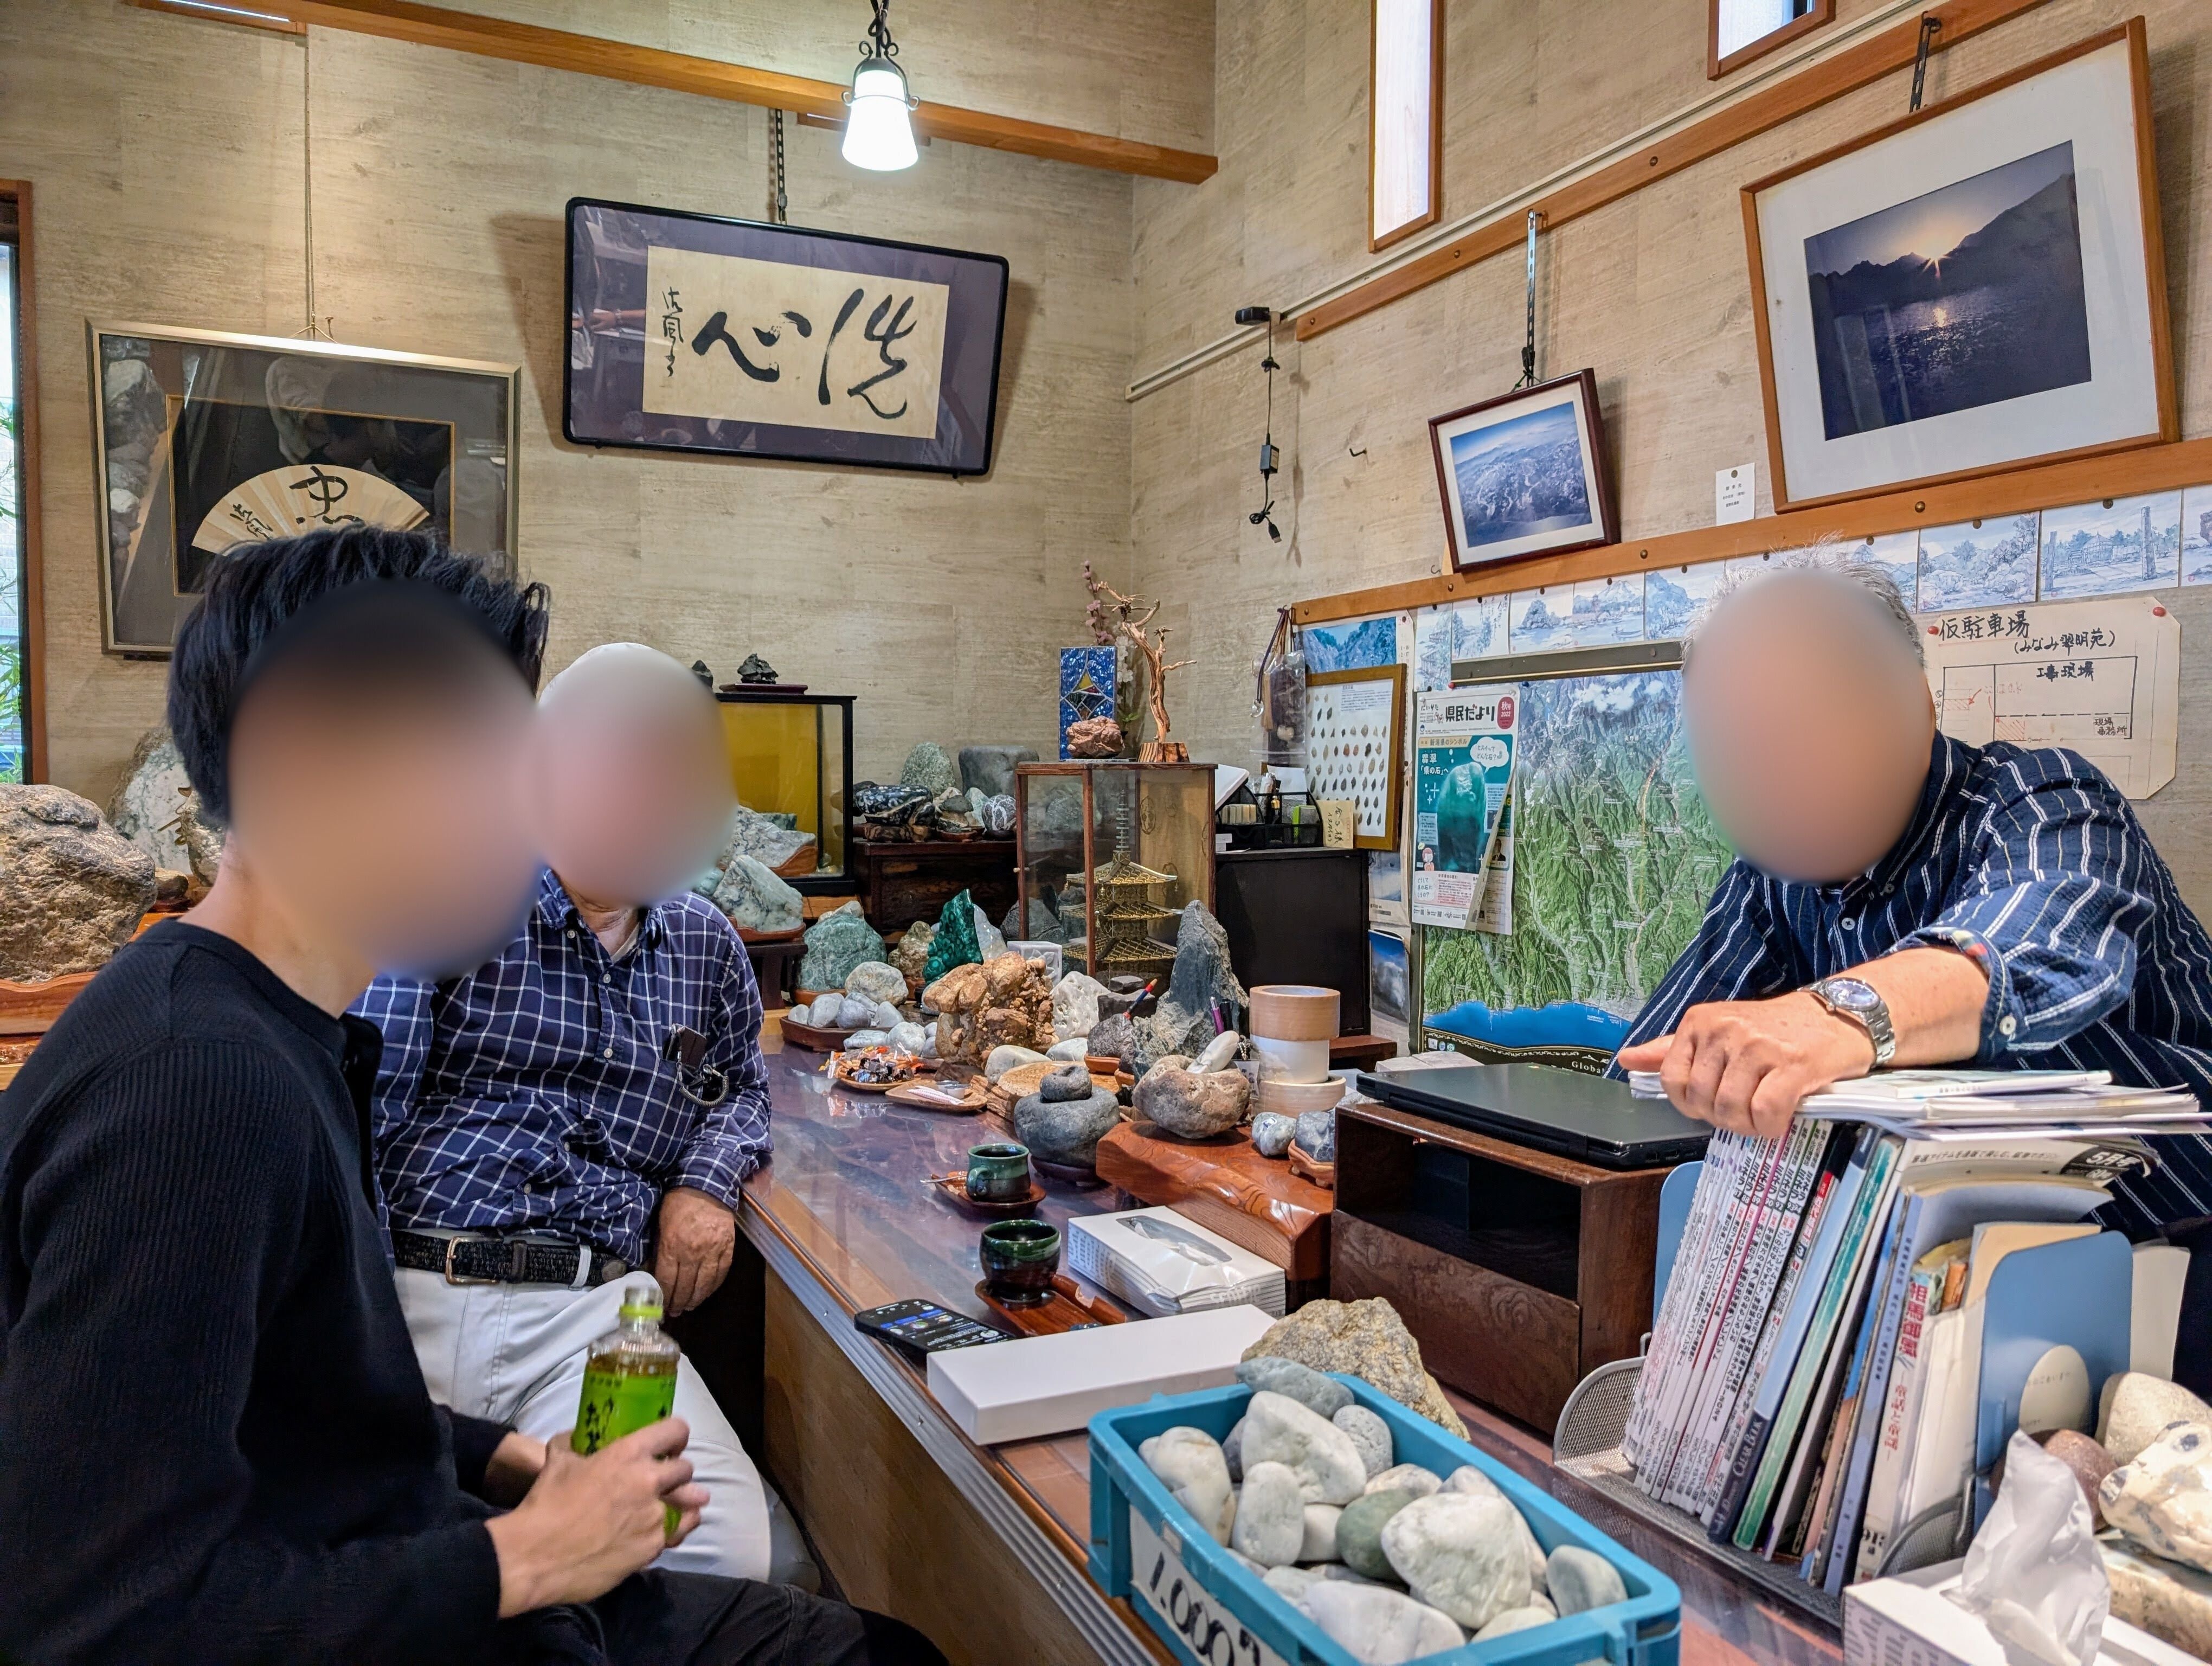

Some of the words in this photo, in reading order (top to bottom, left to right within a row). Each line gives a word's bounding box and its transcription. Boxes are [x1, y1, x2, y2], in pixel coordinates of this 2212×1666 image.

[1939, 610, 2030, 641] 仮駐車場
[2037, 662, 2094, 681] 工事現場
[1421, 703, 1439, 712] にいがた
[1445, 704, 1495, 722] 県民だより
[1430, 738, 1468, 746] 新潟県のシンボル
[1735, 1156, 1753, 1186] ミネラ
[1743, 1161, 1762, 1193] ミネラ
[1754, 1162, 1773, 1193] ミネラ
[1767, 1164, 1785, 1195] ミネラ
[1777, 1168, 1796, 1199] ミネラ
[1789, 1168, 1808, 1200] ミネラ
[1796, 1170, 1815, 1202] ミネラ
[1740, 1194, 1750, 1203] 88
[1751, 1195, 1761, 1204] 89
[1764, 1197, 1774, 1207] 90
[1774, 1201, 1784, 1210] 92
[1786, 1202, 1795, 1210] 93
